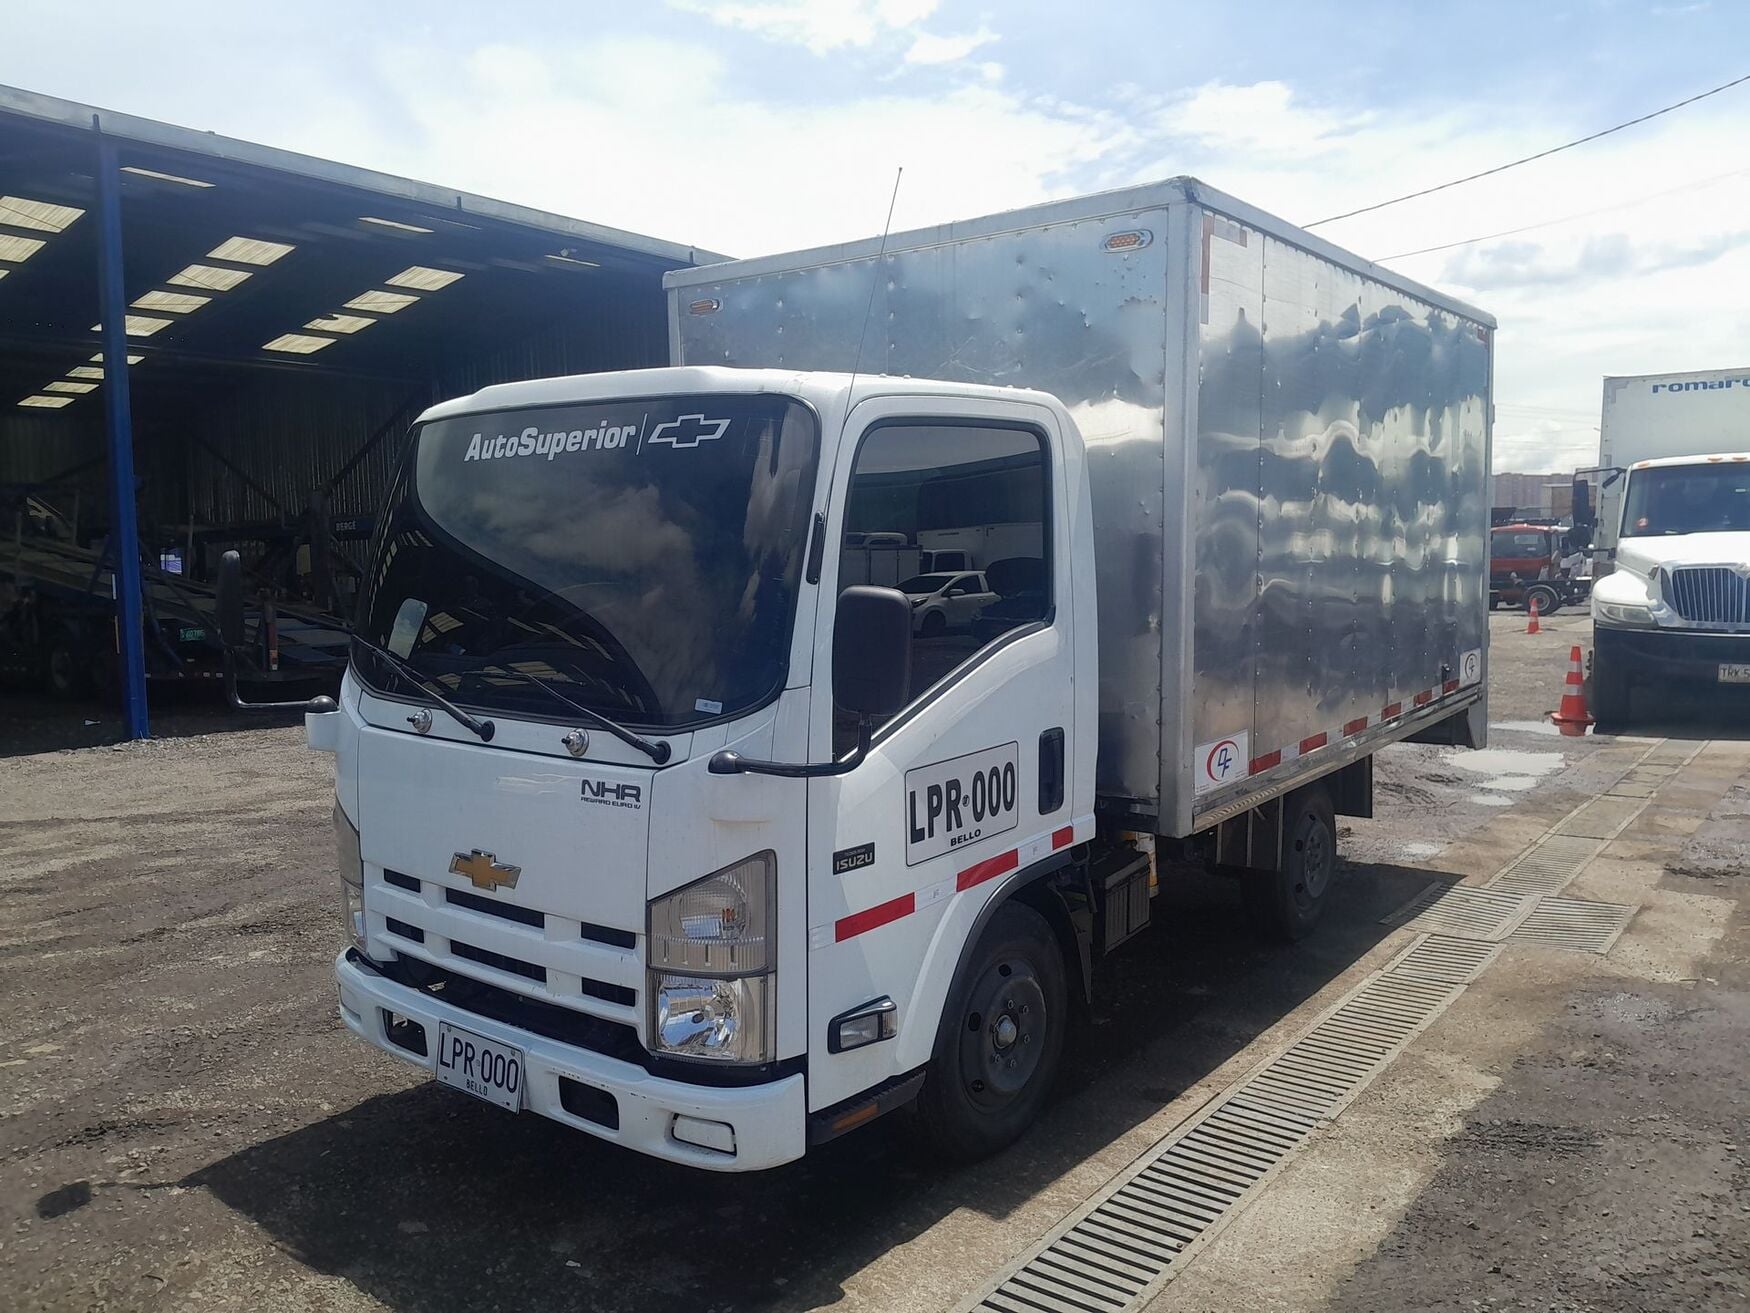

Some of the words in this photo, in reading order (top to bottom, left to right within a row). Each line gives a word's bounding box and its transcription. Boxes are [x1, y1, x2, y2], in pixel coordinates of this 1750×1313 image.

[464, 420, 636, 462] AutoSuperior
[581, 779, 641, 803] NHR
[950, 828, 982, 847] BELLO
[836, 852, 873, 871] ISUZU
[466, 1079, 488, 1096] BELLO
